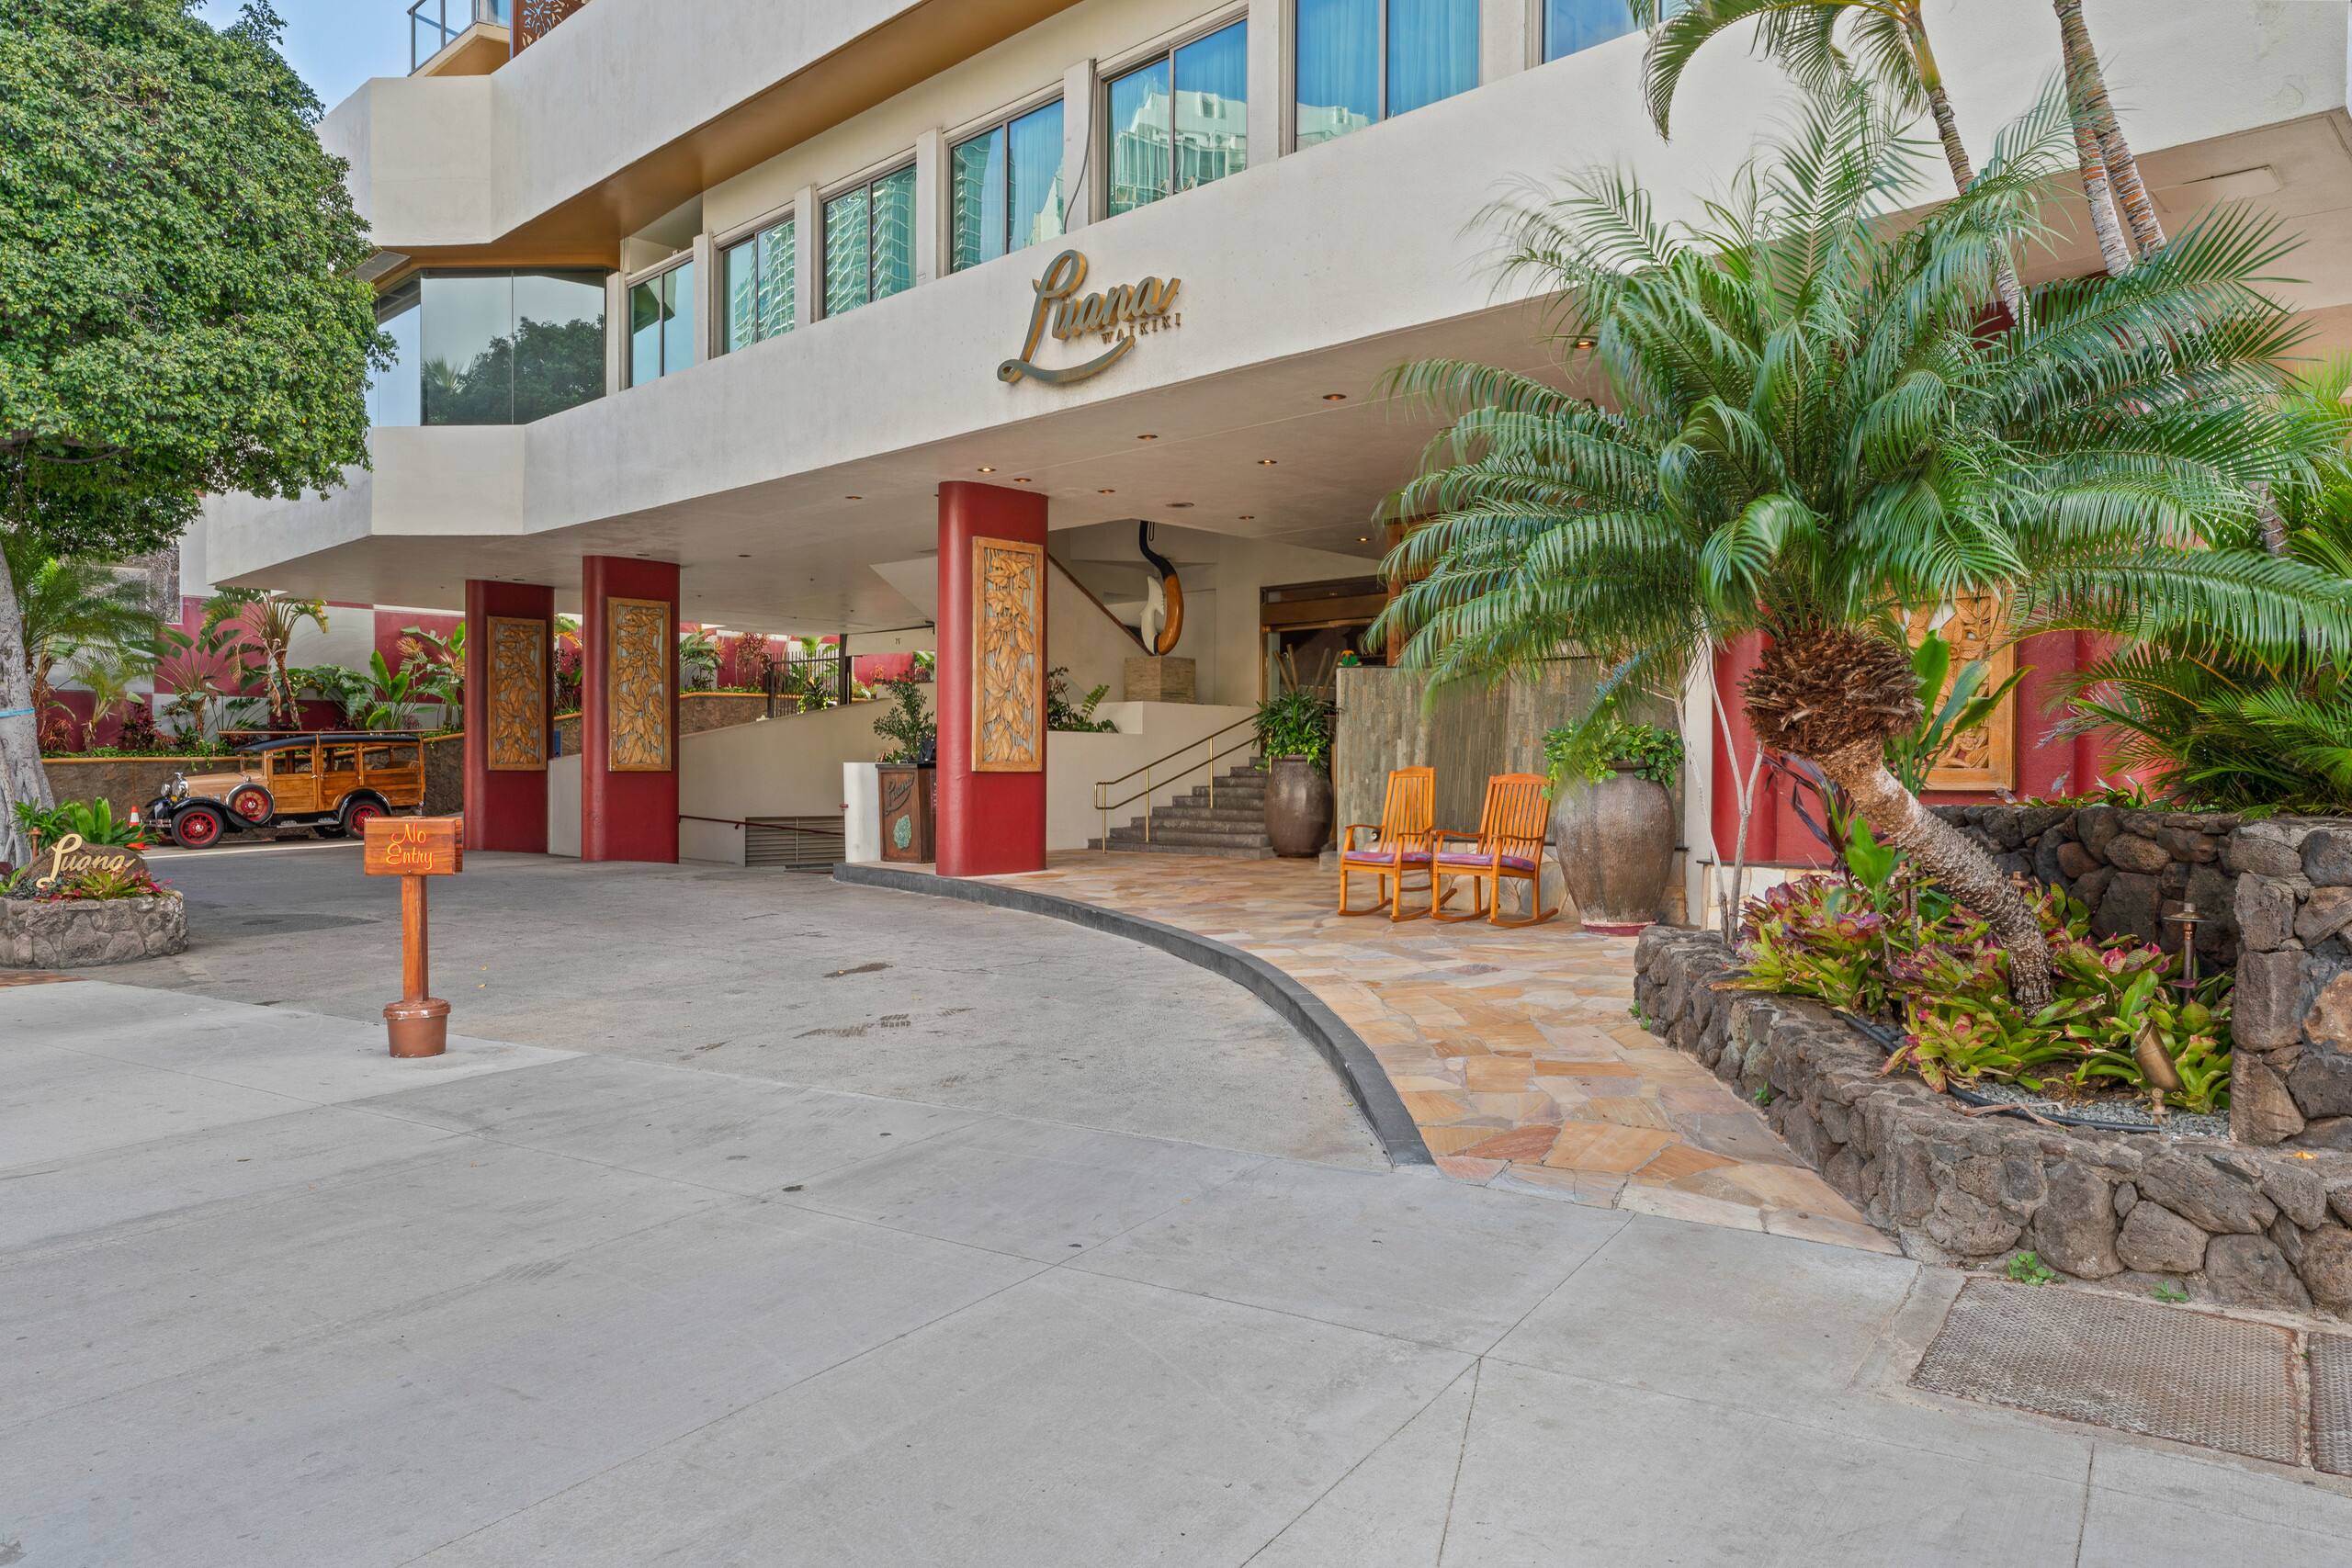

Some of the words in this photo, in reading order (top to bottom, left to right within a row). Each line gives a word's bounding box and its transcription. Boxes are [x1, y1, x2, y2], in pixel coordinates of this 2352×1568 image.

[997, 249, 1182, 383] Luana
[1101, 312, 1182, 344] WAIKIKI
[390, 822, 426, 844] No
[36, 833, 136, 889] Luana
[386, 842, 433, 871] Entry
